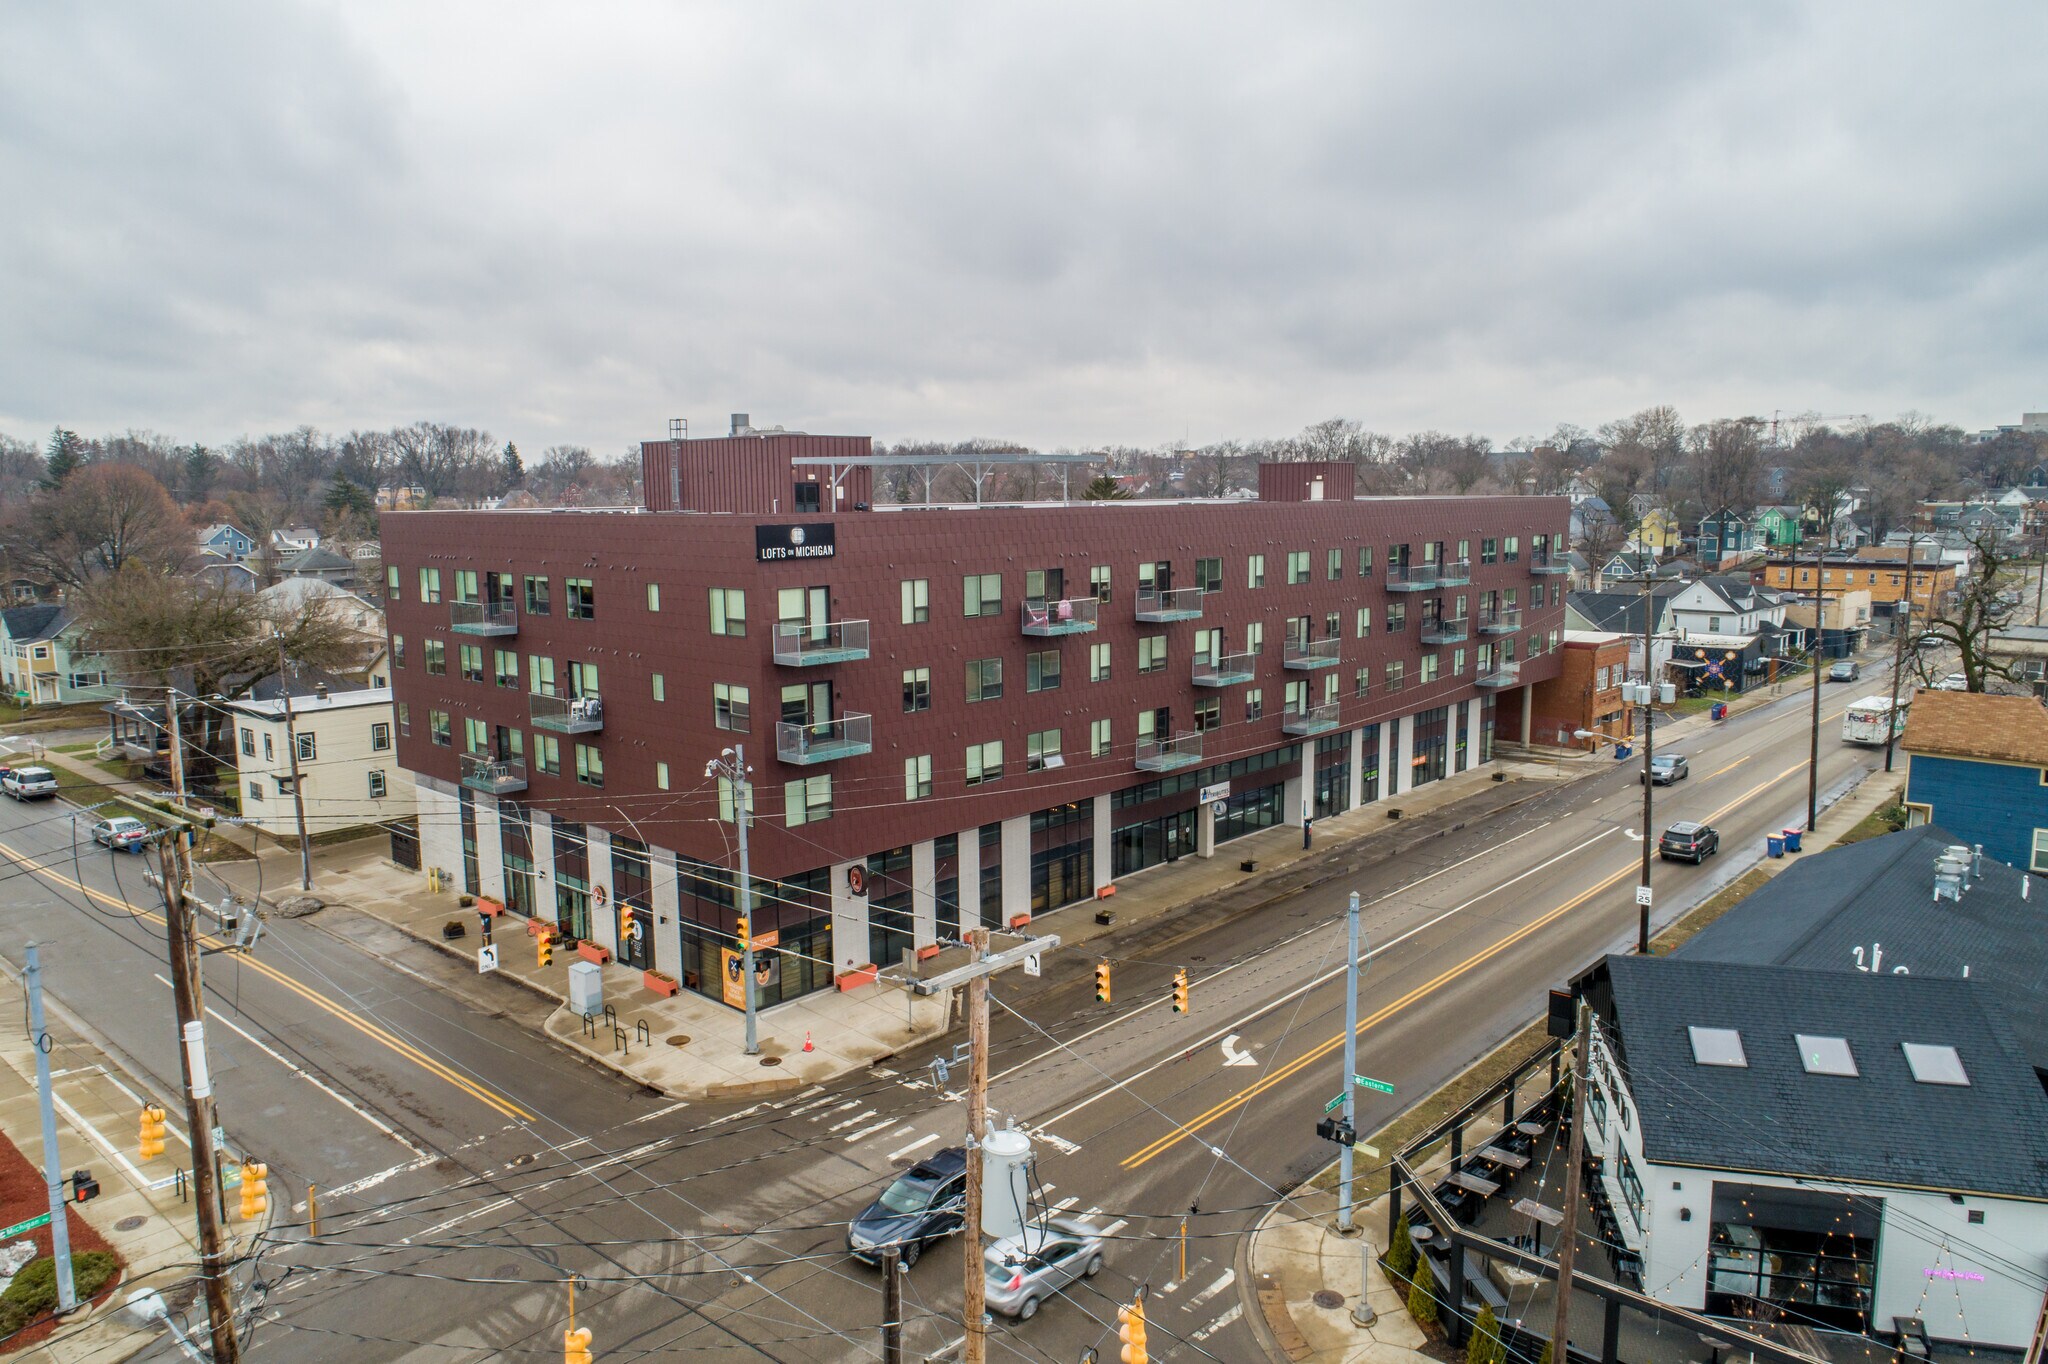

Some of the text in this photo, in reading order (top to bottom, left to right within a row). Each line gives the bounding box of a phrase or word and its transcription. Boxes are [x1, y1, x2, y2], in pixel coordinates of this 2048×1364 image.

[762, 547, 786, 559] LOFTS
[796, 545, 833, 557] MICHIGAN
[1848, 712, 1878, 724] FedEx
[1638, 895, 1651, 904] 25
[759, 935, 776, 944] TAPS
[481, 962, 495, 971] ONLY
[1026, 966, 1038, 974] ONLY
[1360, 1078, 1385, 1090] Eastern
[6, 1219, 40, 1235] Michigan
